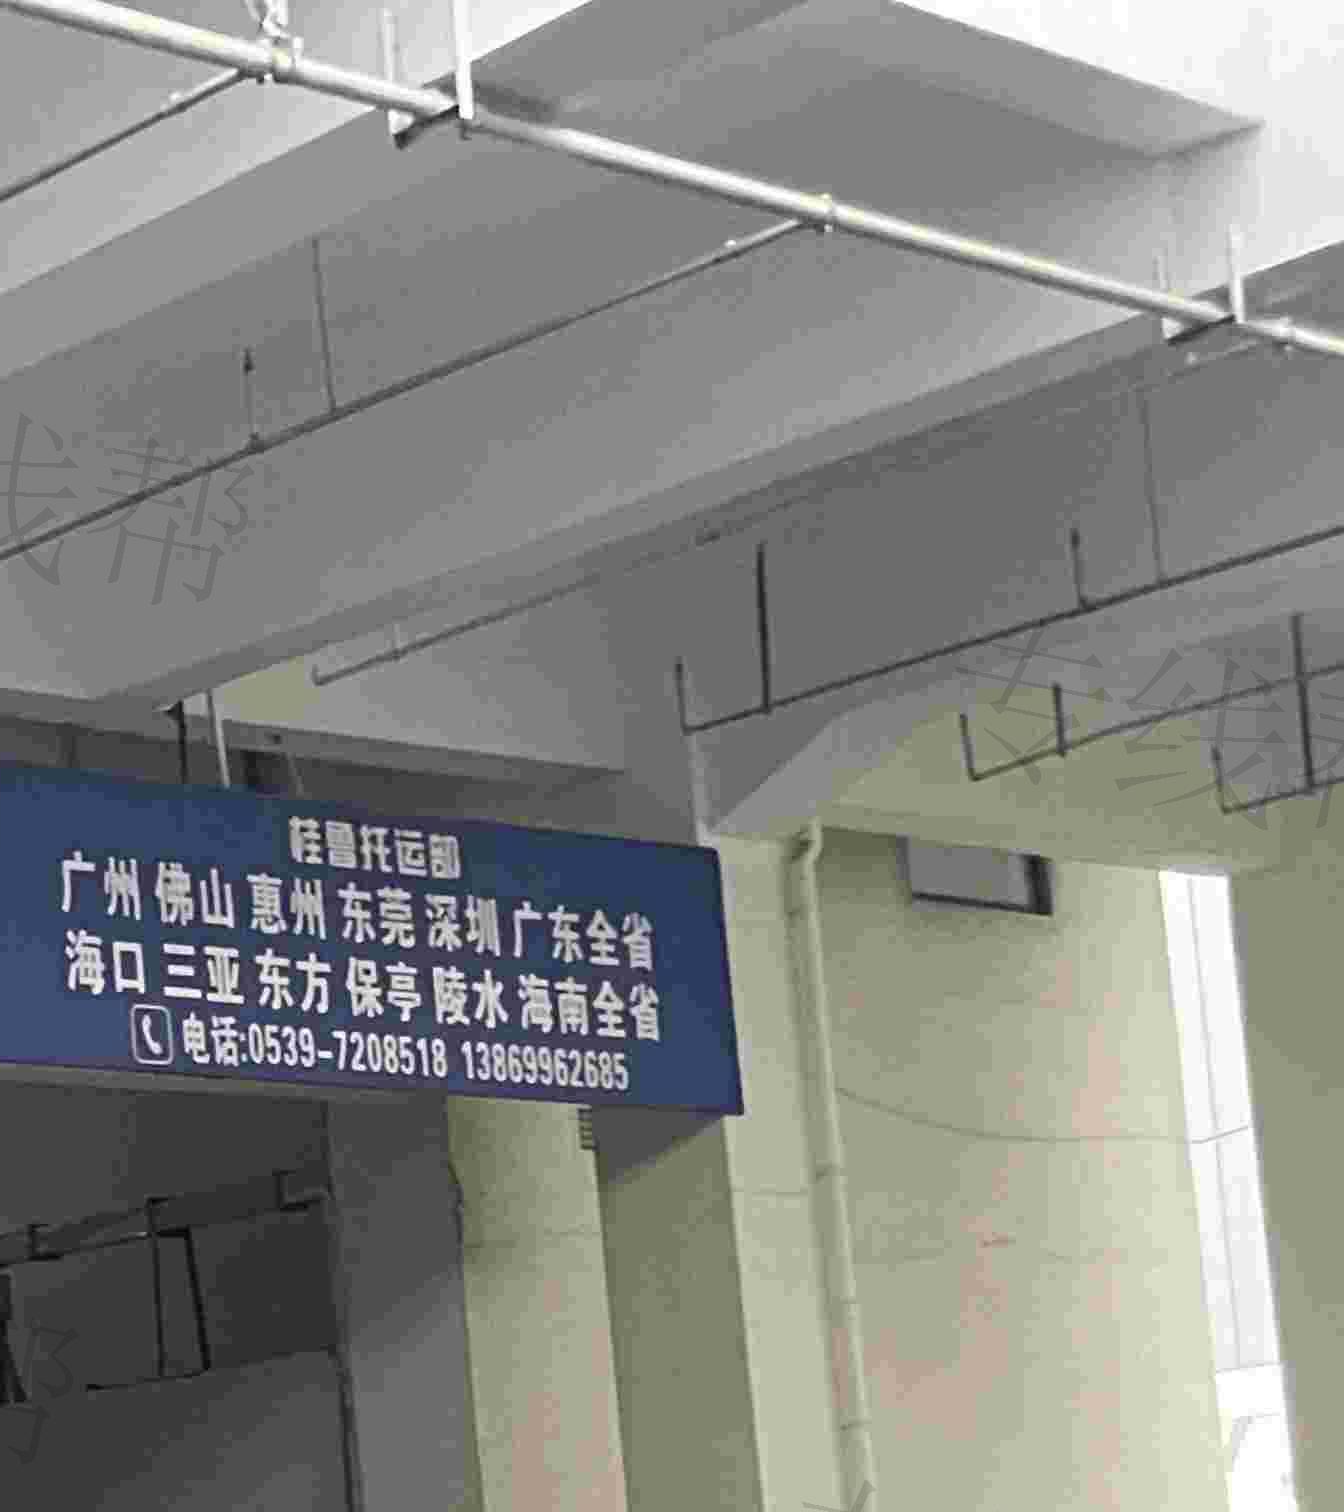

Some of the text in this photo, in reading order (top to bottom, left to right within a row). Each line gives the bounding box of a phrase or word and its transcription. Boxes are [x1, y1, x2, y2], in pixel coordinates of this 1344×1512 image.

[289, 816, 461, 880] 桂鲁托运部
[61, 850, 654, 971] 广州 佛山 惠州 东莞 深圳 广东全省
[65, 929, 660, 1041] 海口 三亚 东方 保亭 陵水 海南全省
[461, 1039, 630, 1090] 13869962685
